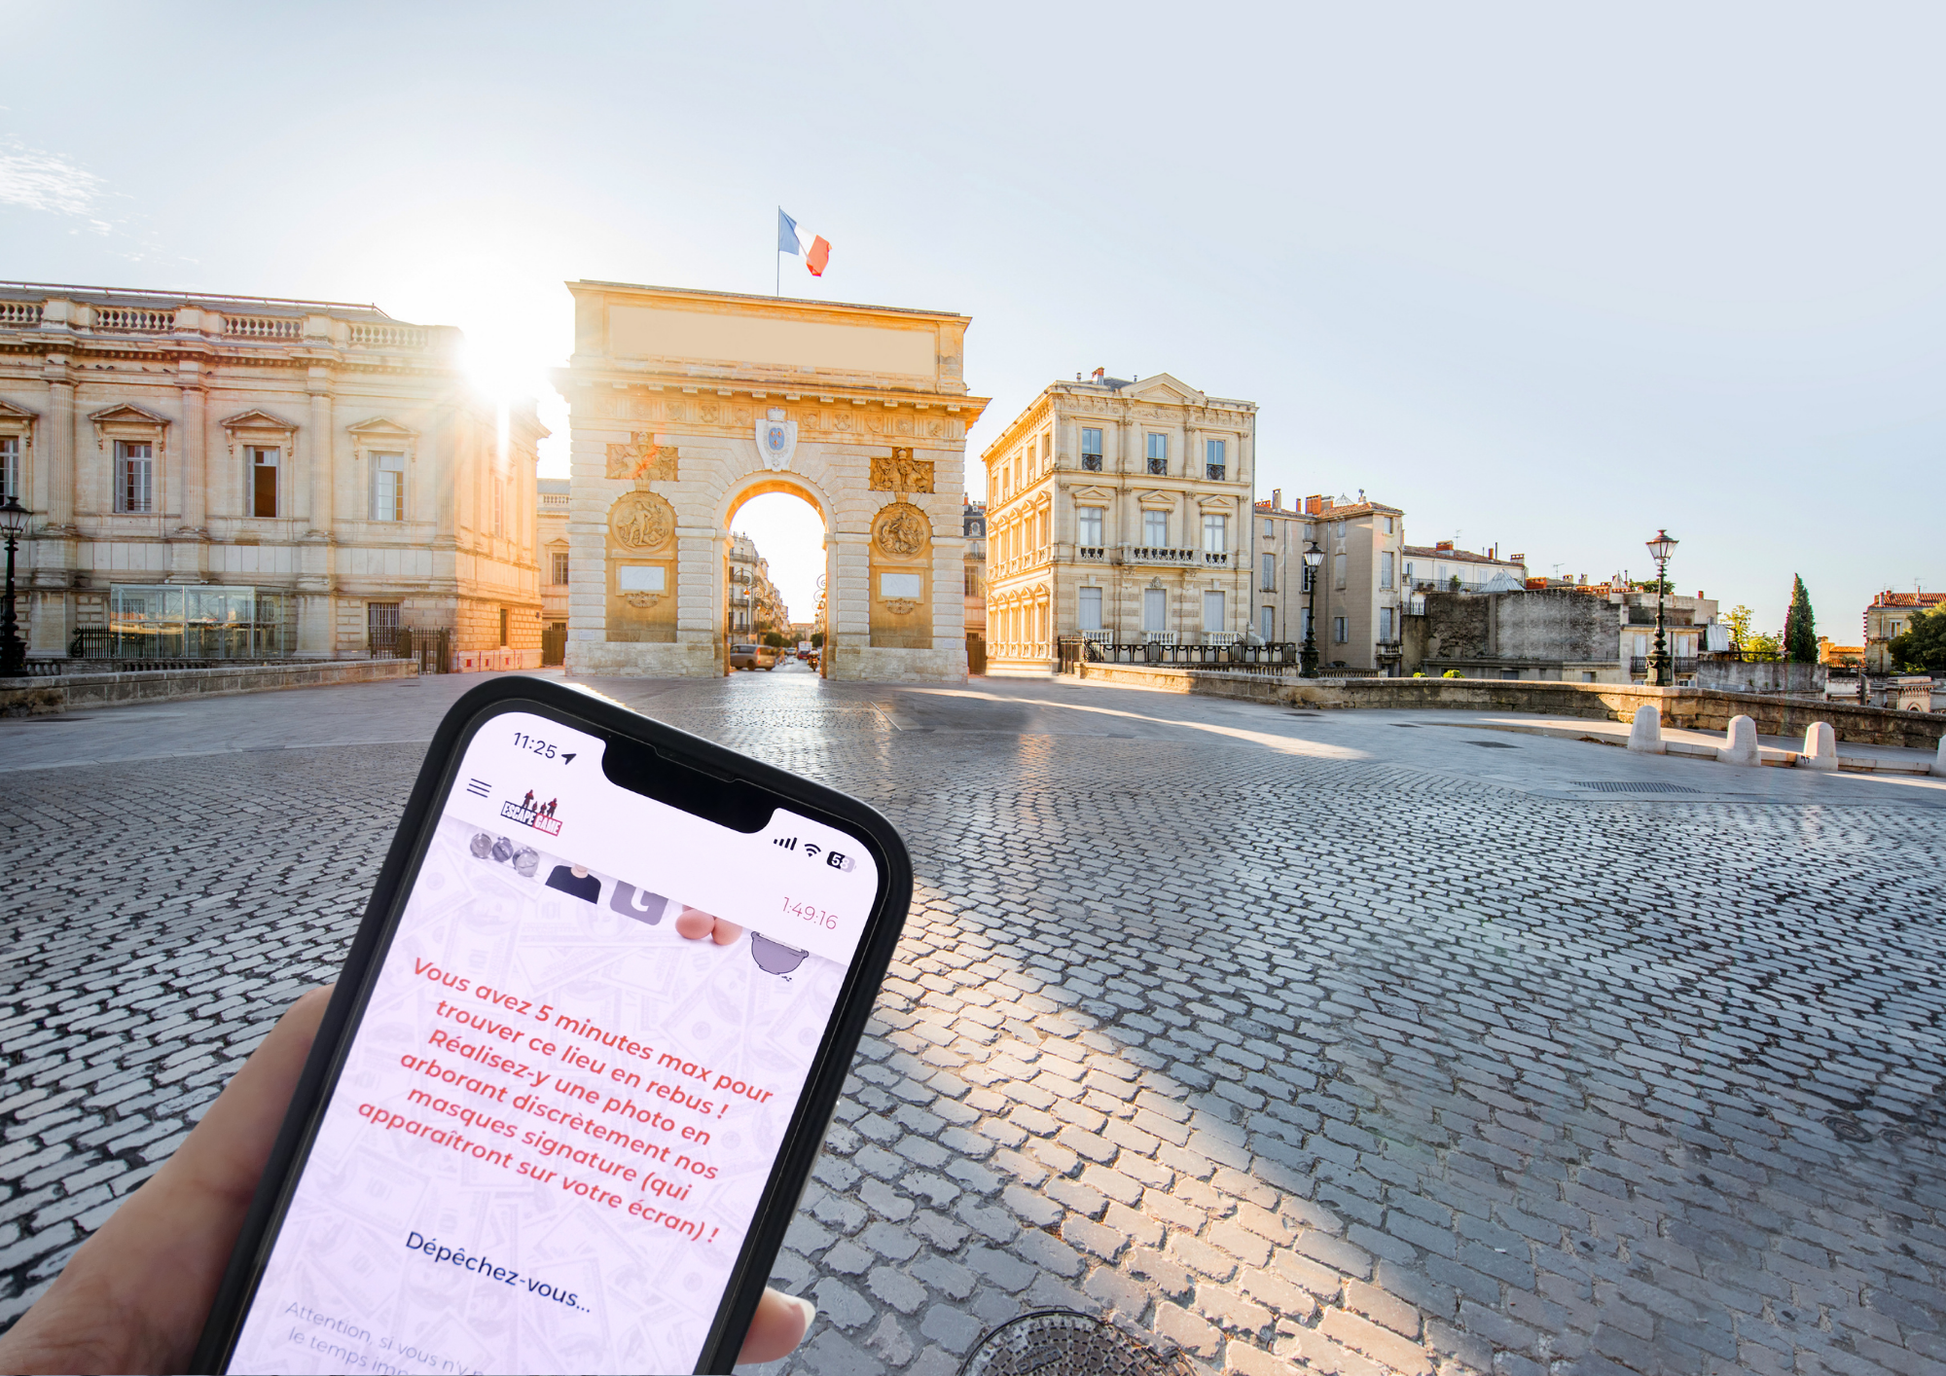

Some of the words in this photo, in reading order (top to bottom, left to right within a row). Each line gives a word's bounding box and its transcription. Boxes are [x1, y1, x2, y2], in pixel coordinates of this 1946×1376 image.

[513, 732, 558, 759] 11:25
[502, 802, 537, 826] ESCAPE
[535, 813, 562, 834] GAME
[830, 854, 851, 871] 58
[782, 896, 839, 930] 1:49:16
[414, 957, 470, 991] Vous
[476, 986, 532, 1016] avez
[535, 1004, 553, 1021] 5
[555, 1014, 653, 1060] minutes
[657, 1052, 713, 1082] max
[713, 1074, 774, 1104] pour
[436, 1000, 525, 1044] trouver
[528, 1037, 557, 1056] ce
[560, 1045, 607, 1075] lieu
[611, 1067, 641, 1088] en
[646, 1080, 714, 1115] rebus
[717, 1103, 730, 1120] !
[400, 1053, 508, 1104] arborant
[512, 1093, 671, 1162] discrètement
[674, 1154, 719, 1180] nos
[428, 1029, 551, 1087] Réalisez-y
[555, 1078, 601, 1105] une
[602, 1096, 676, 1132] photo
[681, 1125, 711, 1146] en
[358, 1102, 513, 1169] apparaîtront
[517, 1162, 558, 1184] sur
[562, 1176, 623, 1209] votre
[628, 1199, 706, 1242] écran)
[407, 1088, 518, 1138] masques
[521, 1130, 637, 1181] signature
[641, 1171, 693, 1202] (qui
[405, 1231, 591, 1313] Dépêchez-vous...
[284, 1301, 373, 1346] Attention,
[379, 1336, 394, 1350] si
[399, 1343, 438, 1367] vous
[288, 1326, 305, 1344] le
[310, 1336, 368, 1367] temps
